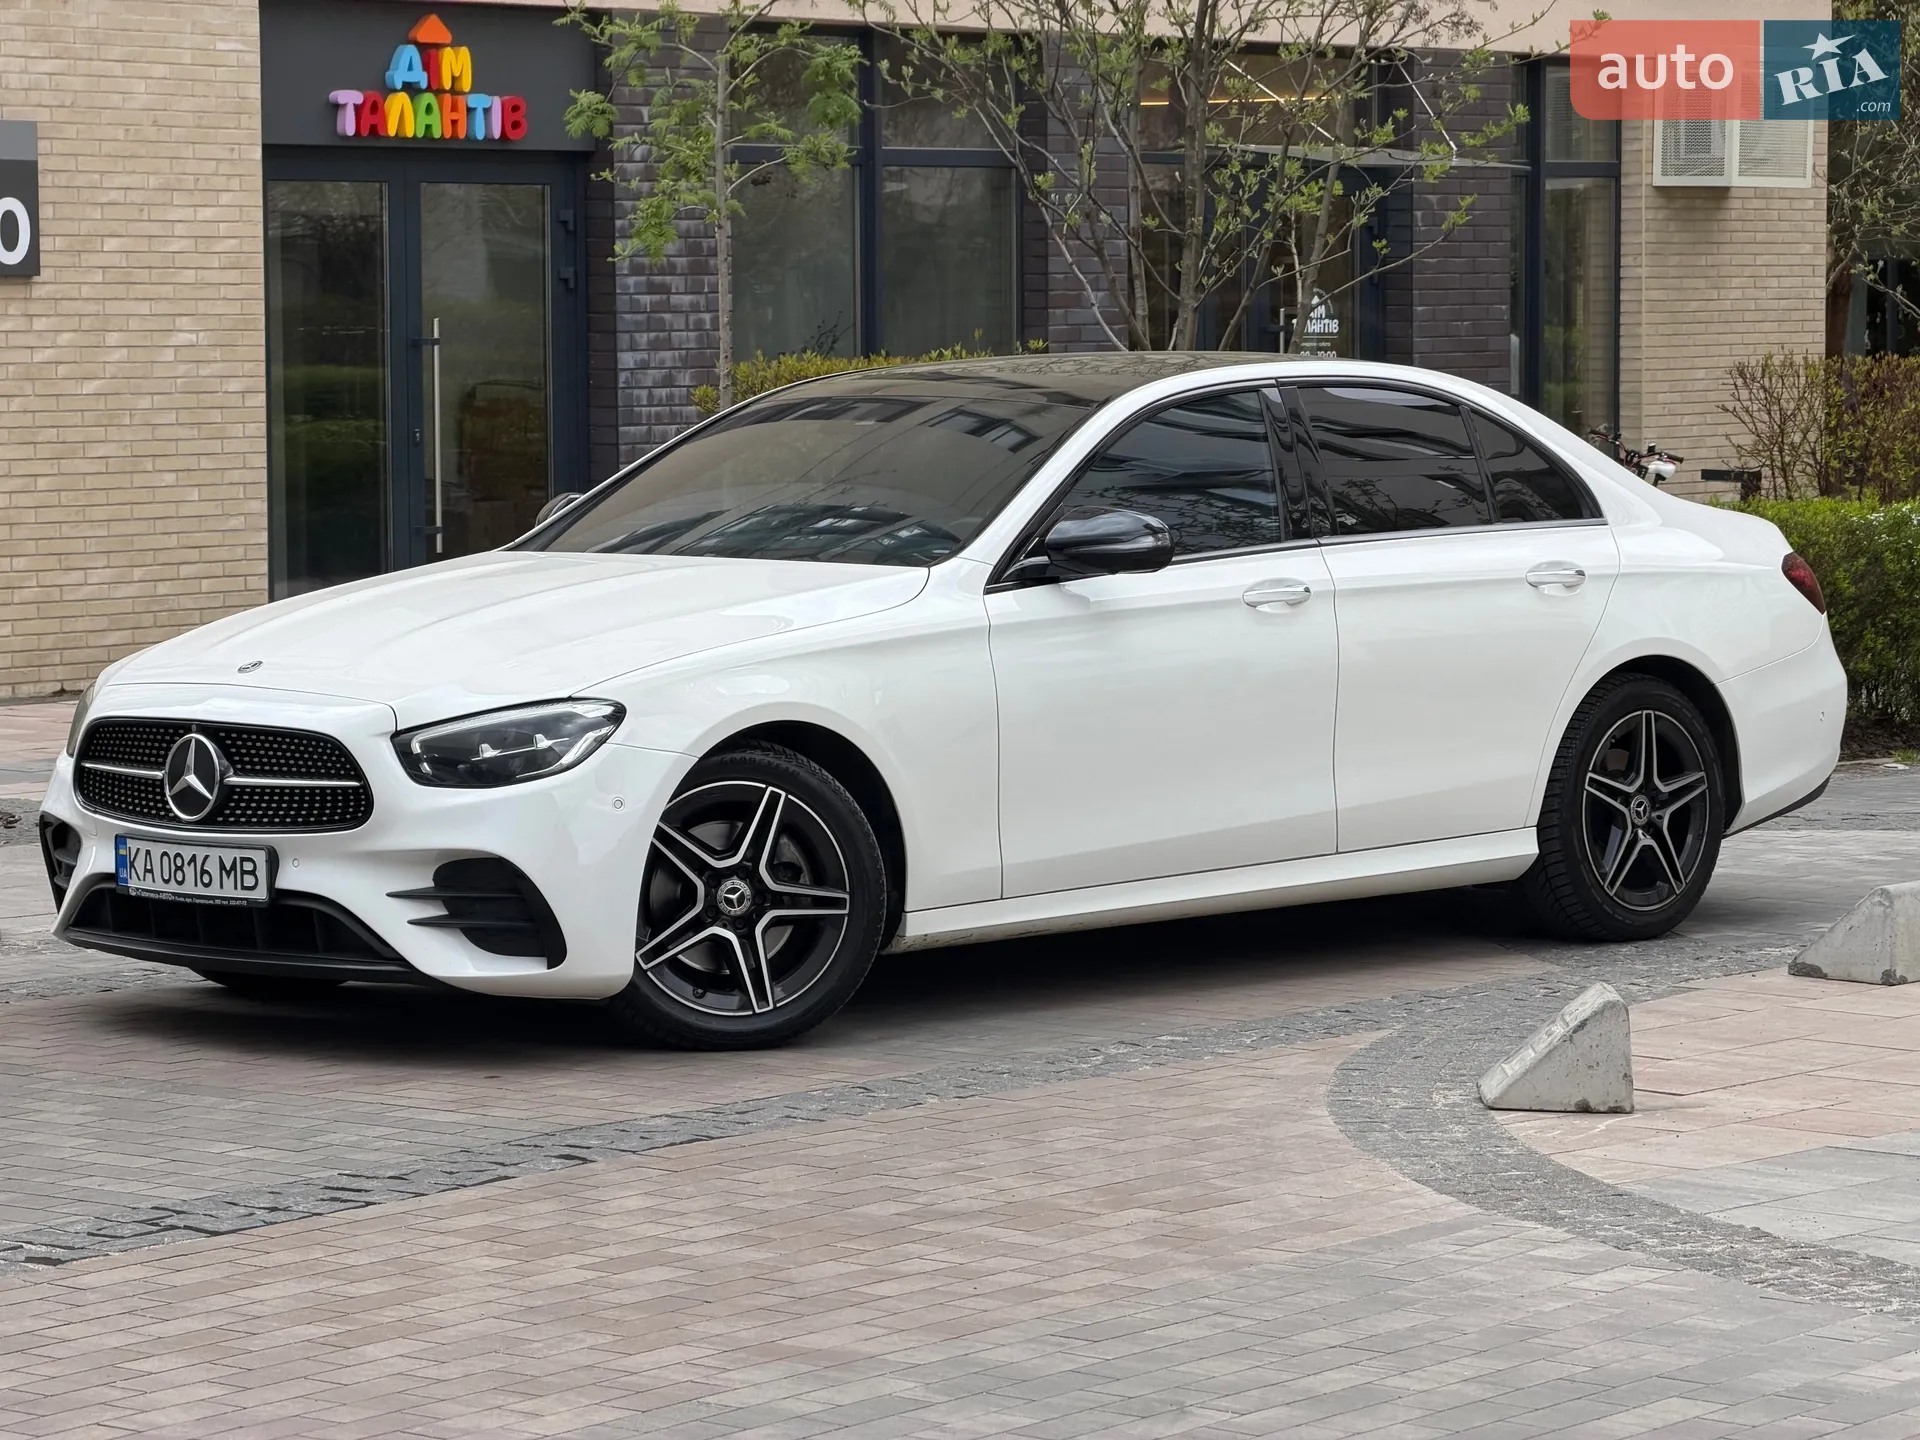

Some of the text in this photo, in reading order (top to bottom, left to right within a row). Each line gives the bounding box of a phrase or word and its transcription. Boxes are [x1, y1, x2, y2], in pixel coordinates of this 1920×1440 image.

[385, 44, 472, 93] ДІМ
[328, 89, 528, 141] ТАЛАНТІВ
[1292, 318, 1339, 333] ТЛАНТІВ
[119, 867, 128, 878] UA
[128, 846, 259, 891] KA 0816 MB
